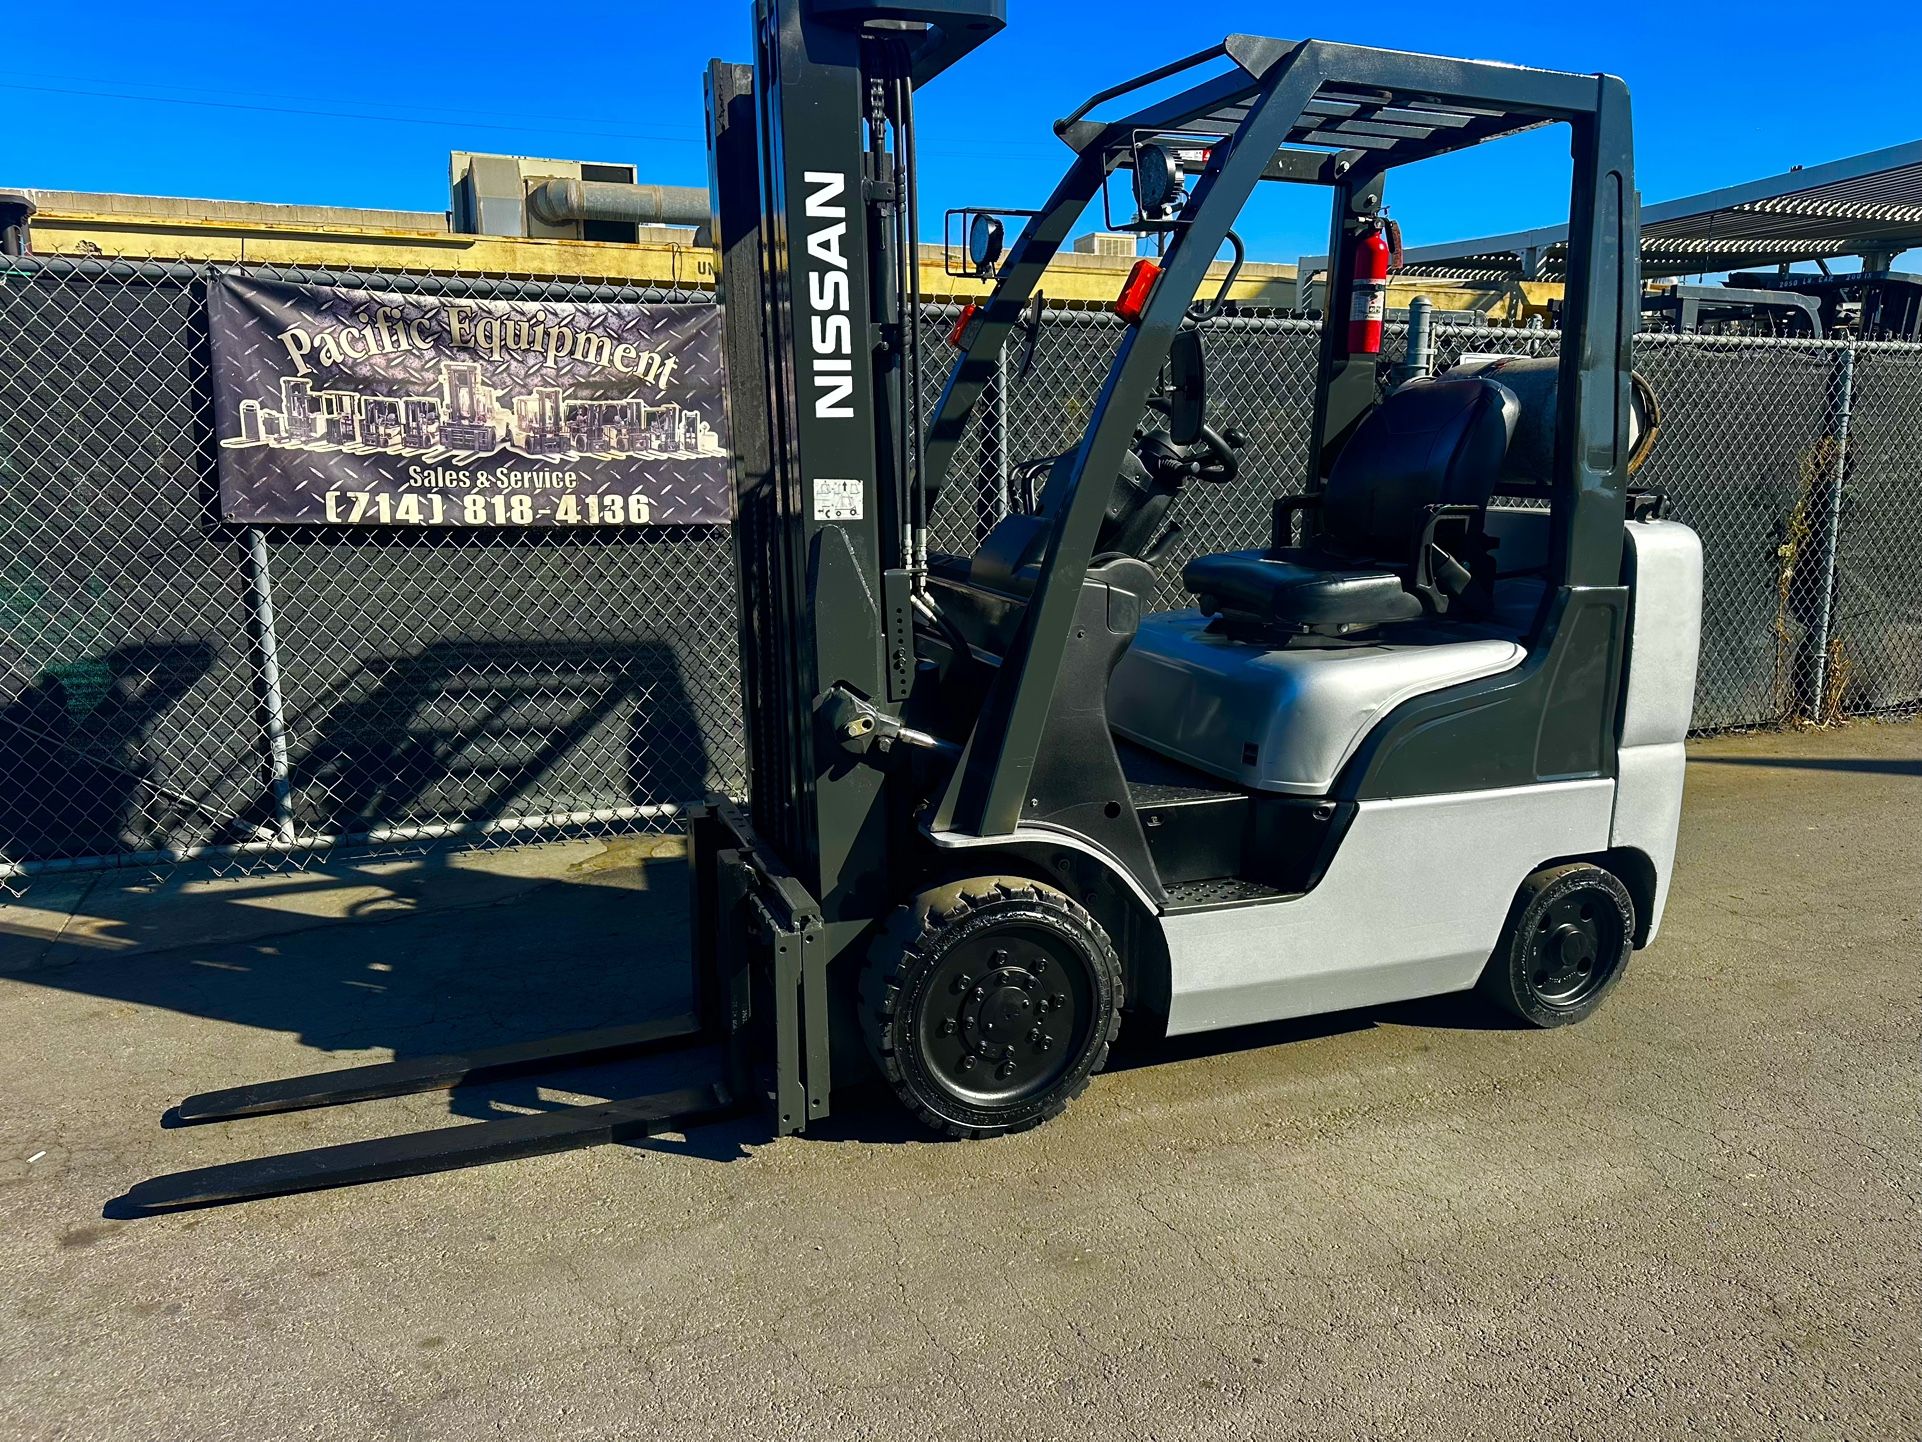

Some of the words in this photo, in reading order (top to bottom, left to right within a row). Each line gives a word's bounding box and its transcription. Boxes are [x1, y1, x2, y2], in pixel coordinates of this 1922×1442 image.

[804, 171, 854, 418] NISSAN
[277, 305, 435, 377] Pacific
[443, 305, 679, 391] Equipment
[408, 465, 470, 489] Sales
[475, 468, 491, 489] &
[495, 468, 578, 489] Service
[325, 490, 444, 524] (714)
[463, 493, 651, 525] 818-4136
